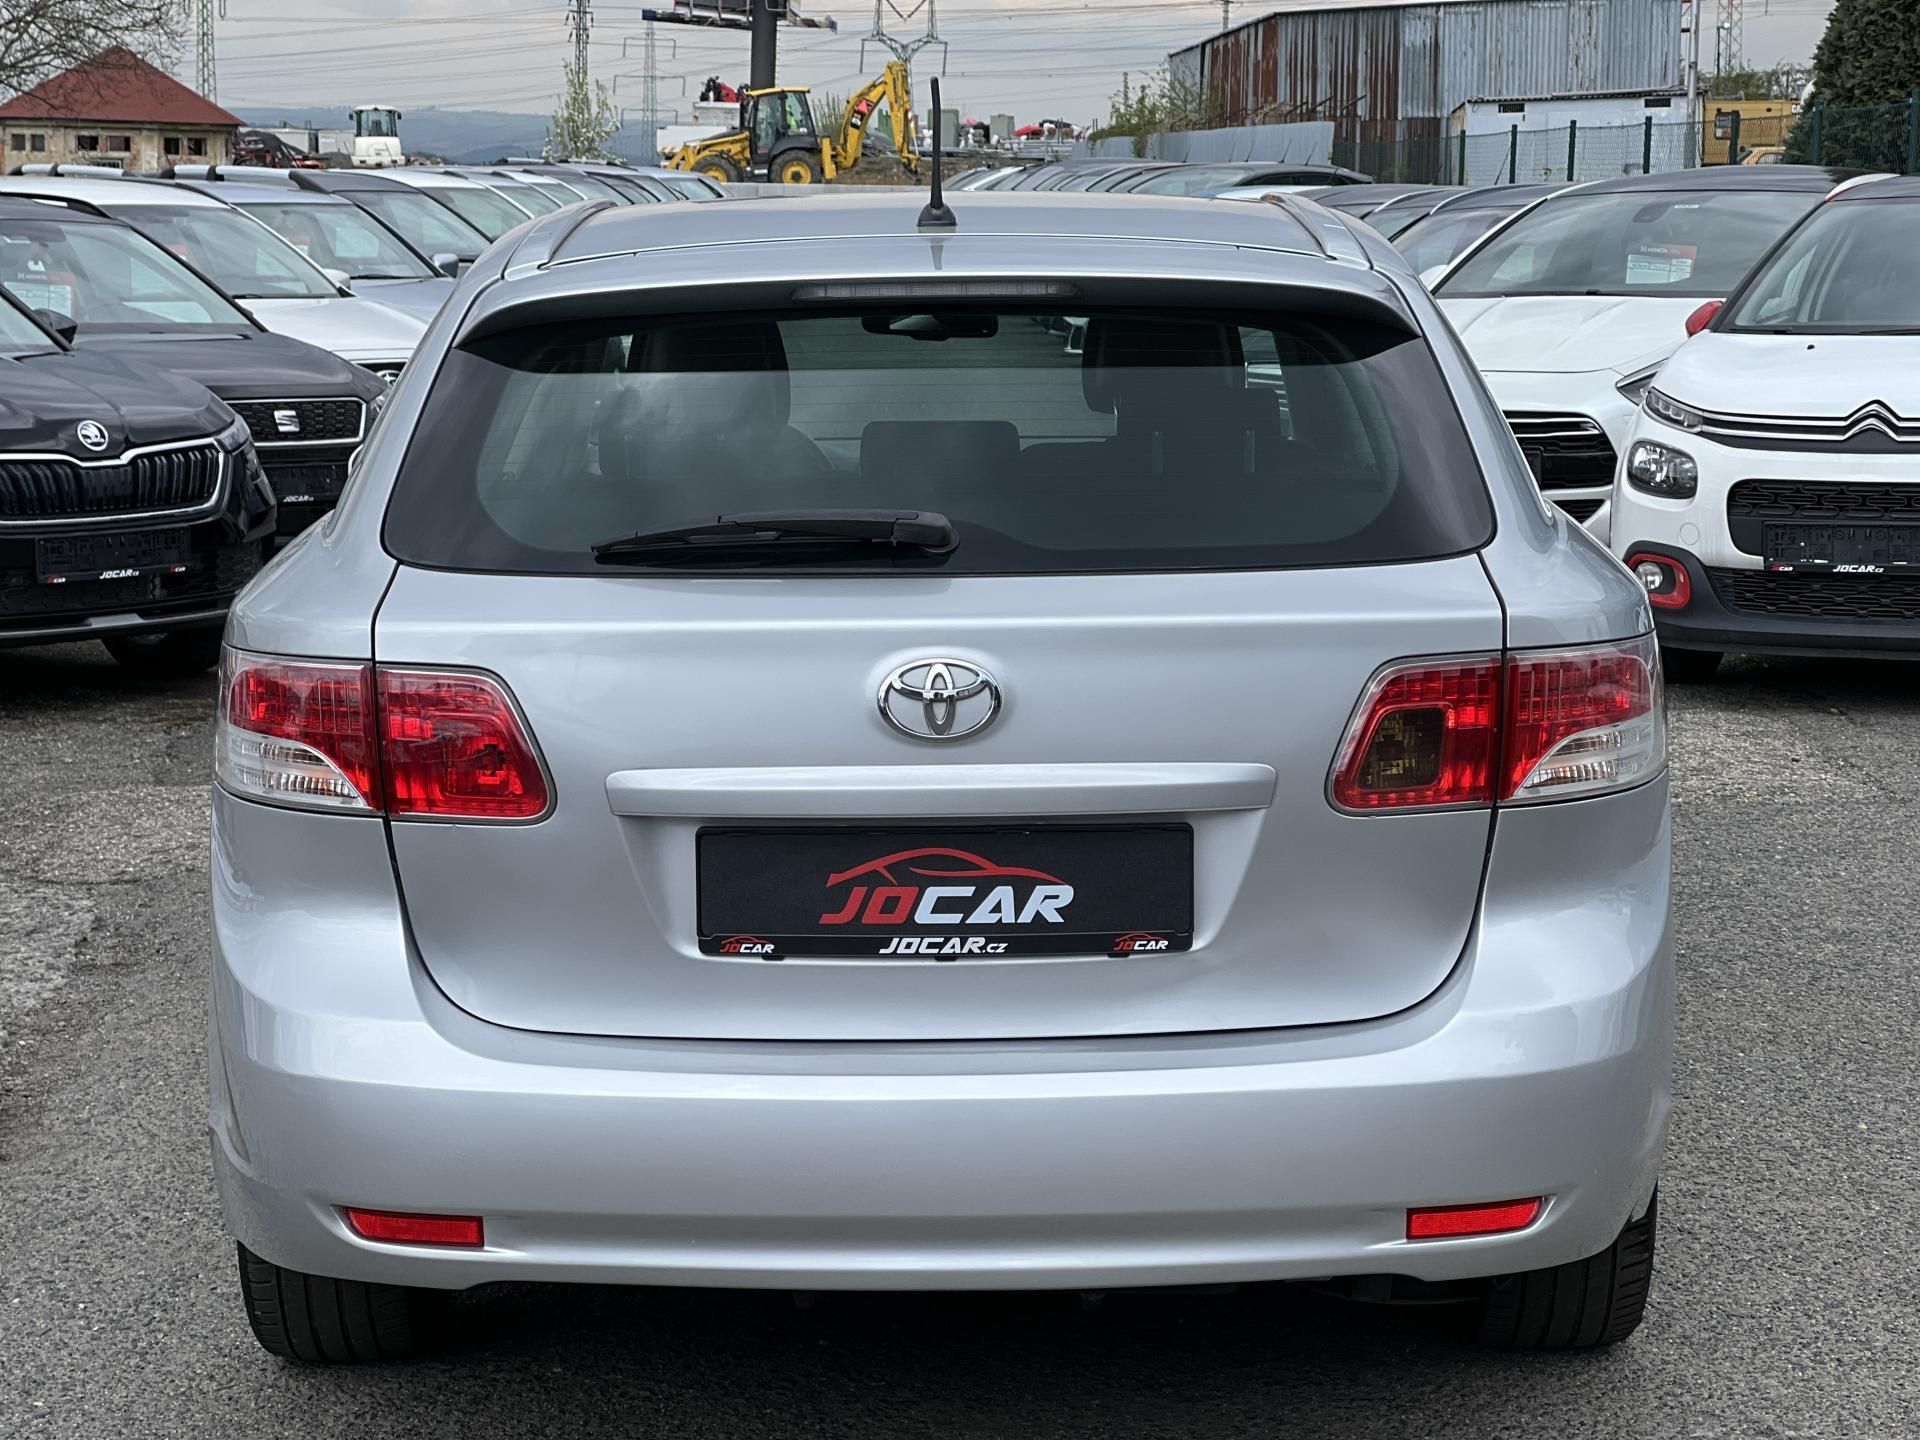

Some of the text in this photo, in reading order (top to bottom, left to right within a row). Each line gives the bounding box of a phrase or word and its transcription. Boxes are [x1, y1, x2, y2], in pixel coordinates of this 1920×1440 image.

[820, 885, 1074, 924] JOCAR
[720, 943, 775, 954] JOCAR
[878, 937, 1008, 955] JOCAR.cz
[1113, 940, 1169, 951] JOCAR
